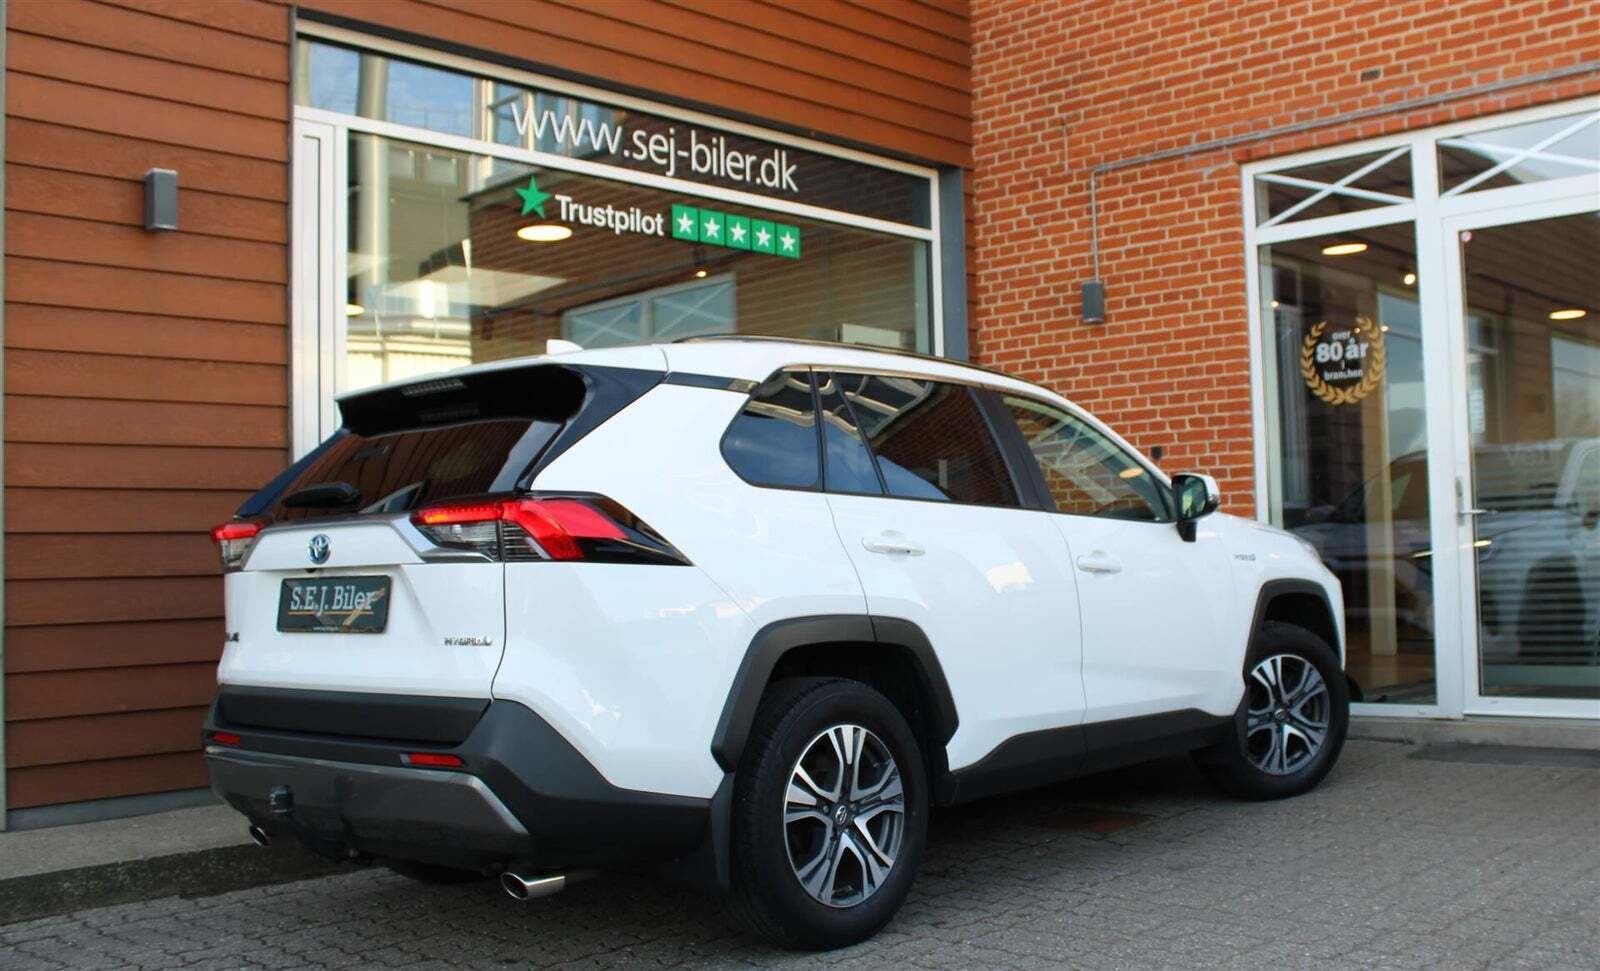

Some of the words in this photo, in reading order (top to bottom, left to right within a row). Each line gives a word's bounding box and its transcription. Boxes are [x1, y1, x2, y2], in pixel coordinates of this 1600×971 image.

[510, 101, 799, 193] www.sej-biler.dk
[554, 194, 665, 237] Trustpilot
[1316, 342, 1343, 363] 80
[1345, 337, 1369, 360] år
[290, 586, 328, 614] S.E.J.
[331, 585, 375, 611] Biler
